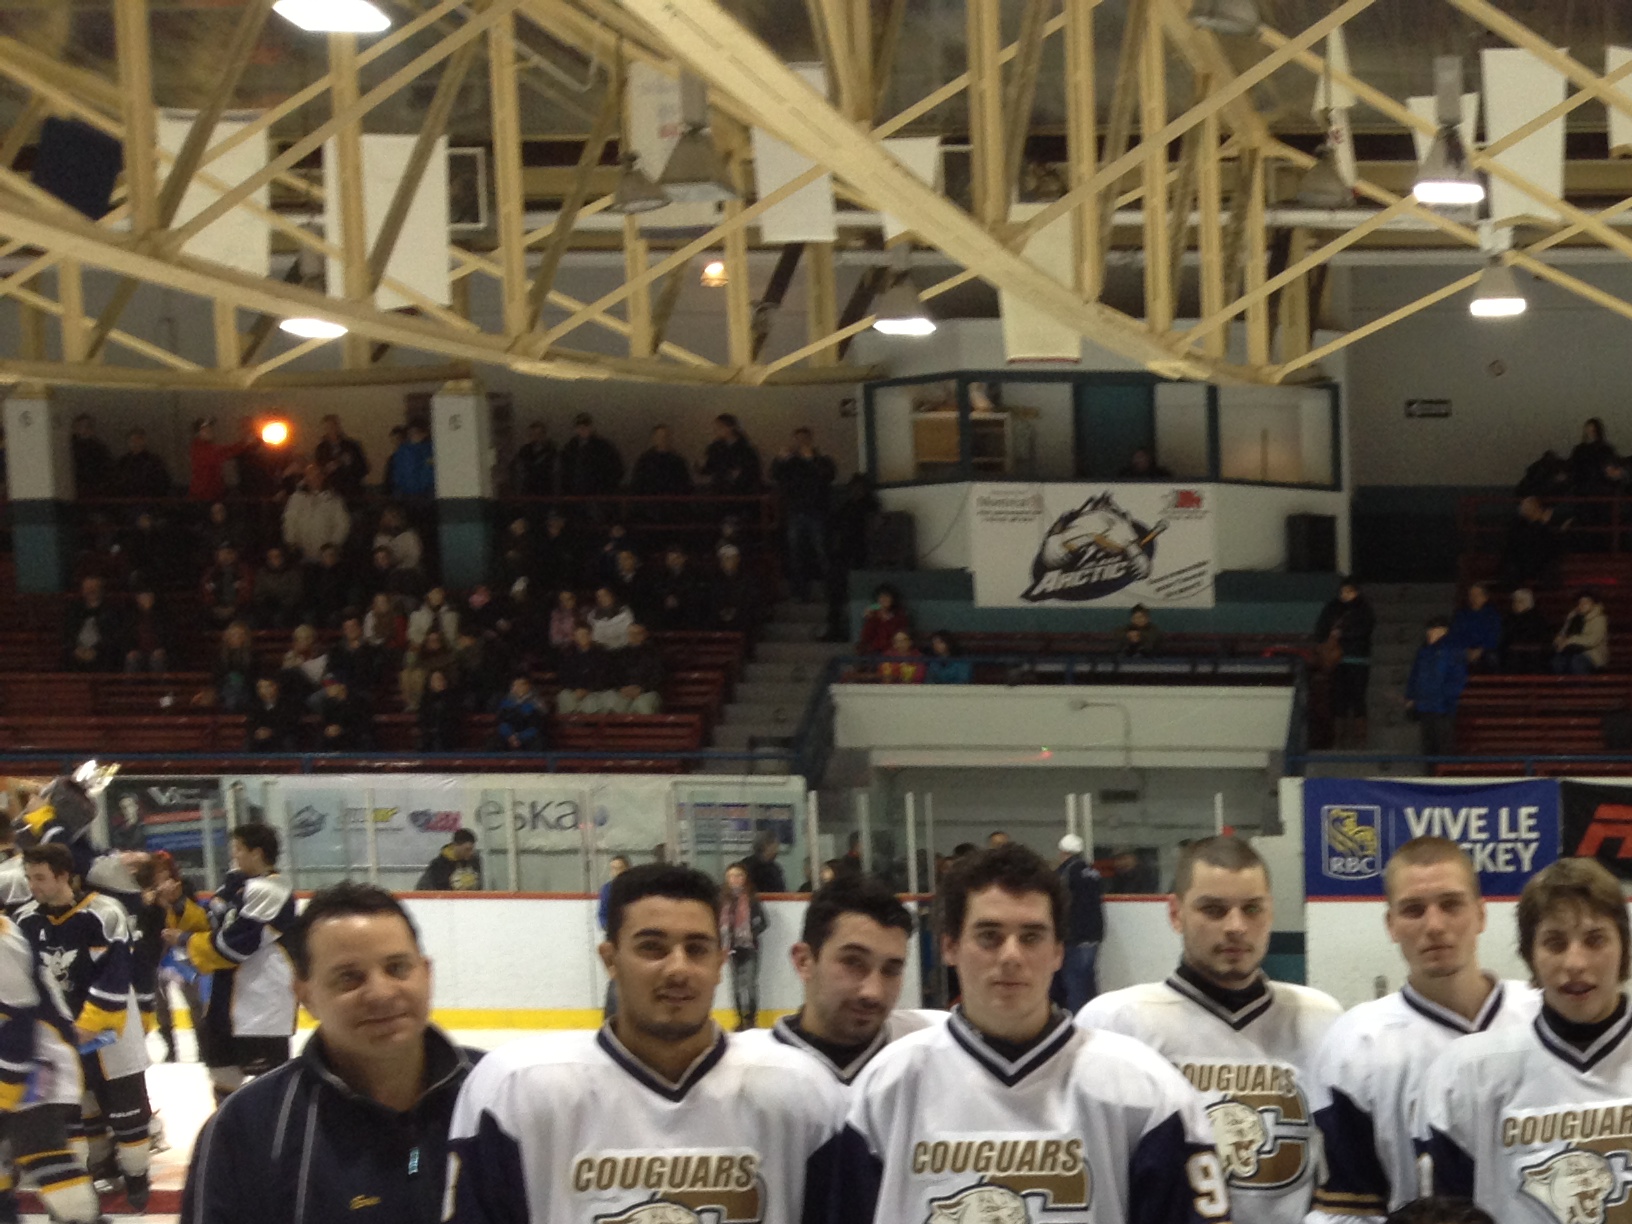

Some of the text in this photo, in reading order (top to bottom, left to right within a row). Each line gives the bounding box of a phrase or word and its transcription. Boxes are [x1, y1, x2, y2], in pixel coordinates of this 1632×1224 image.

[1404, 806, 1540, 840] VIVE LE
[1329, 856, 1376, 874] RBC
[1460, 842, 1540, 873] KEY
[1182, 1062, 1298, 1096] OUGUARS
[574, 1154, 757, 1192] COUGUARS
[911, 1139, 1083, 1176] COUGUARS
